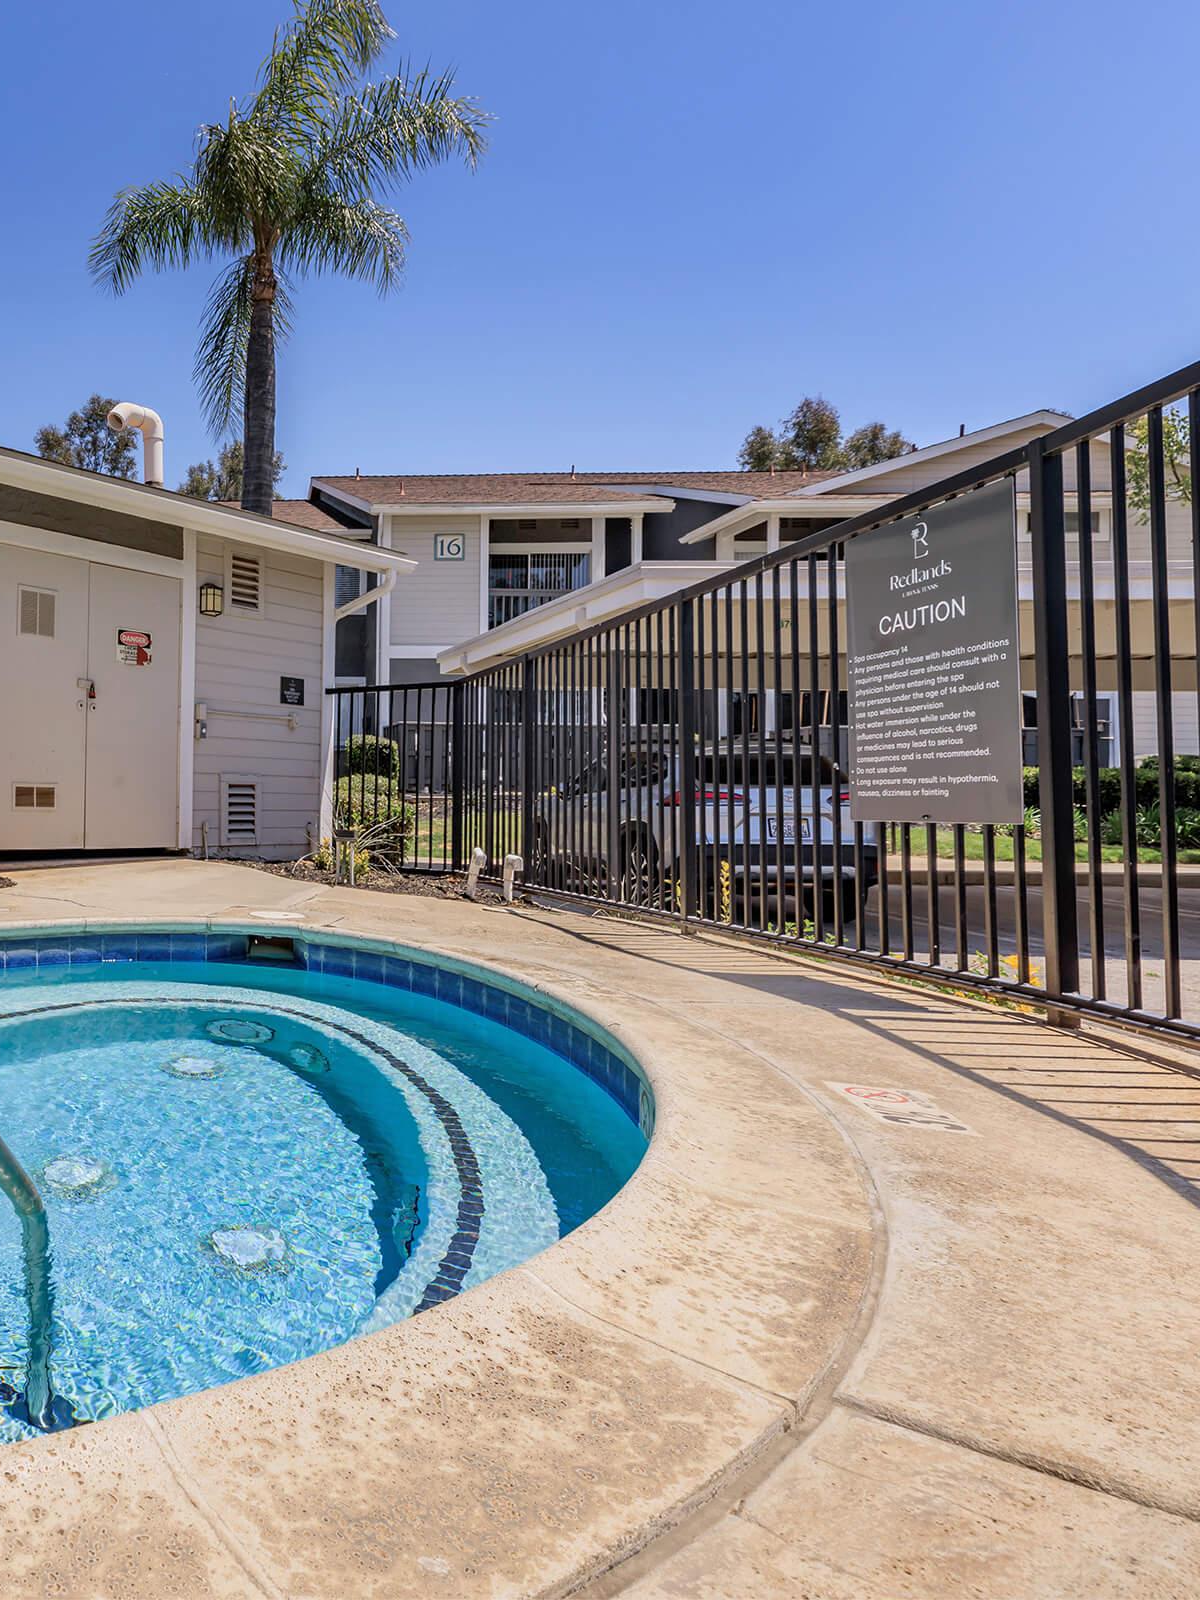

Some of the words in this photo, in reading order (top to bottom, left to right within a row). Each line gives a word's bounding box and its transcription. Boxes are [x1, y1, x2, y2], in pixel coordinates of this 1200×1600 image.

[440, 538, 461, 556] 16
[890, 559, 952, 591] Redlands
[879, 596, 966, 635] CAUTION
[866, 649, 900, 660] occupancy
[901, 645, 908, 653] 14
[866, 663, 890, 673] persons
[891, 659, 904, 667] and
[905, 656, 923, 664] those
[925, 651, 940, 660] with
[942, 646, 965, 657] health
[967, 639, 1009, 652] conditions
[856, 676, 881, 685] requiring
[883, 669, 908, 680] medical
[927, 661, 950, 672] should
[952, 657, 979, 668] consult
[982, 653, 998, 663] with
[856, 687, 883, 697] physician
[885, 683, 905, 691] before
[907, 679, 935, 688] entering
[937, 675, 949, 683] the
[951, 674, 964, 682] spa
[867, 698, 890, 706] persons
[892, 694, 911, 702] under
[925, 690, 938, 698] age
[940, 687, 947, 695] of
[950, 686, 956, 694] 14
[959, 682, 984, 693] should
[986, 680, 1000, 688] not
[880, 707, 903, 715] without
[905, 702, 943, 712] supervision
[885, 717, 919, 726] immersion
[920, 714, 938, 722] while
[940, 712, 961, 720] under
[963, 710, 976, 718] the
[956, 724, 977, 732] drugs
[937, 737, 963, 745] serious
[857, 755, 899, 763] consequences
[936, 747, 991, 758] recommended.
[889, 765, 907, 773] alone
[857, 779, 871, 787] Long
[948, 773, 998, 784] hypothermia,
[922, 788, 949, 797] fainting
